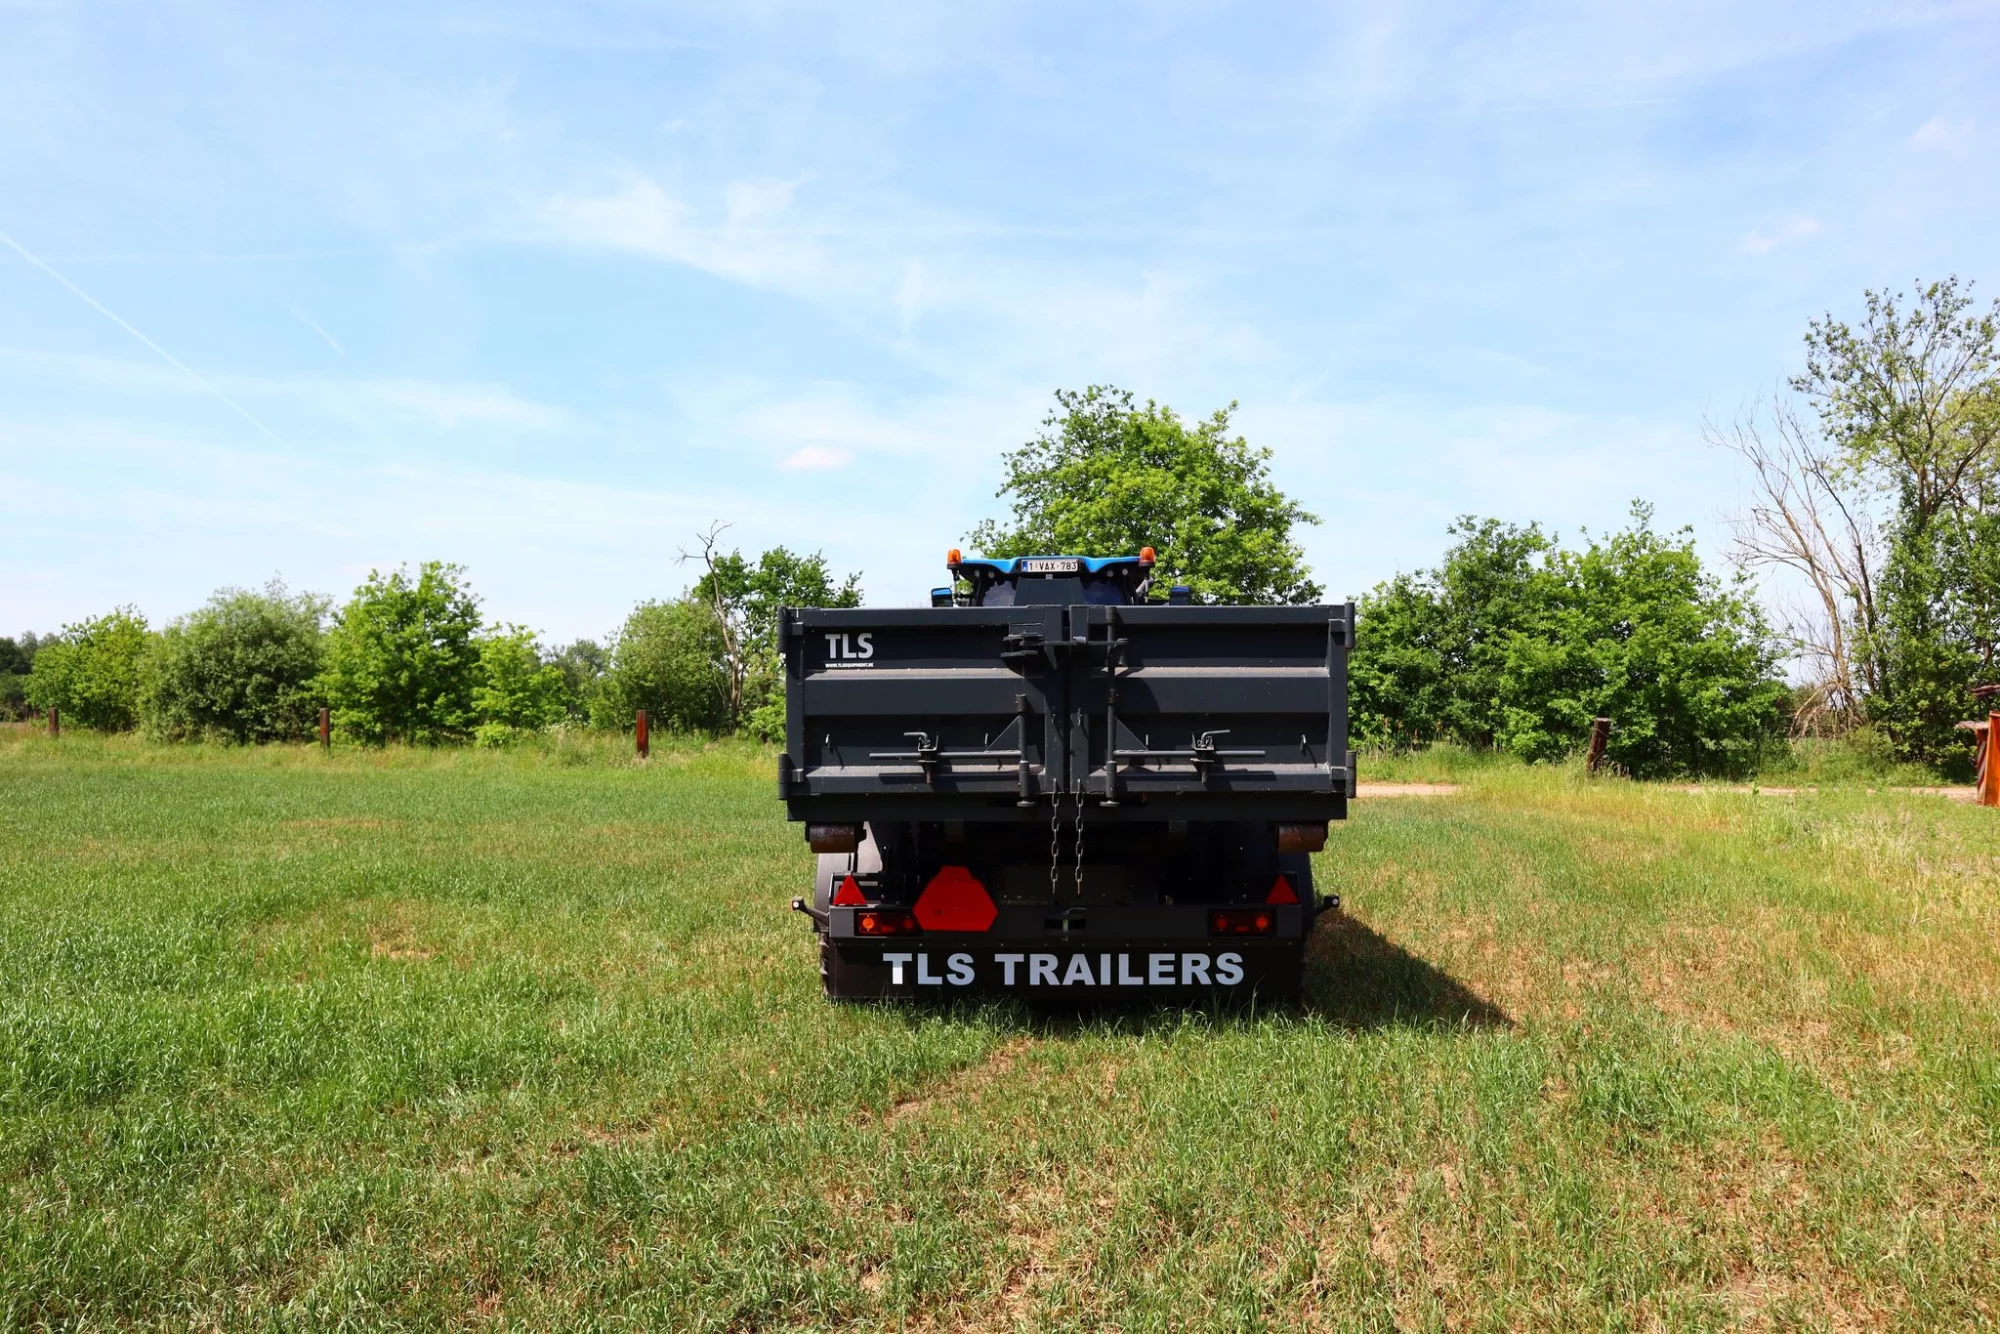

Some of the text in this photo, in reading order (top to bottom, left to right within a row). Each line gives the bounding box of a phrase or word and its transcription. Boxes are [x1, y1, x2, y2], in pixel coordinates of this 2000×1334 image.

[824, 632, 874, 659] TLS
[882, 952, 1244, 986] TLS TRAILERS
